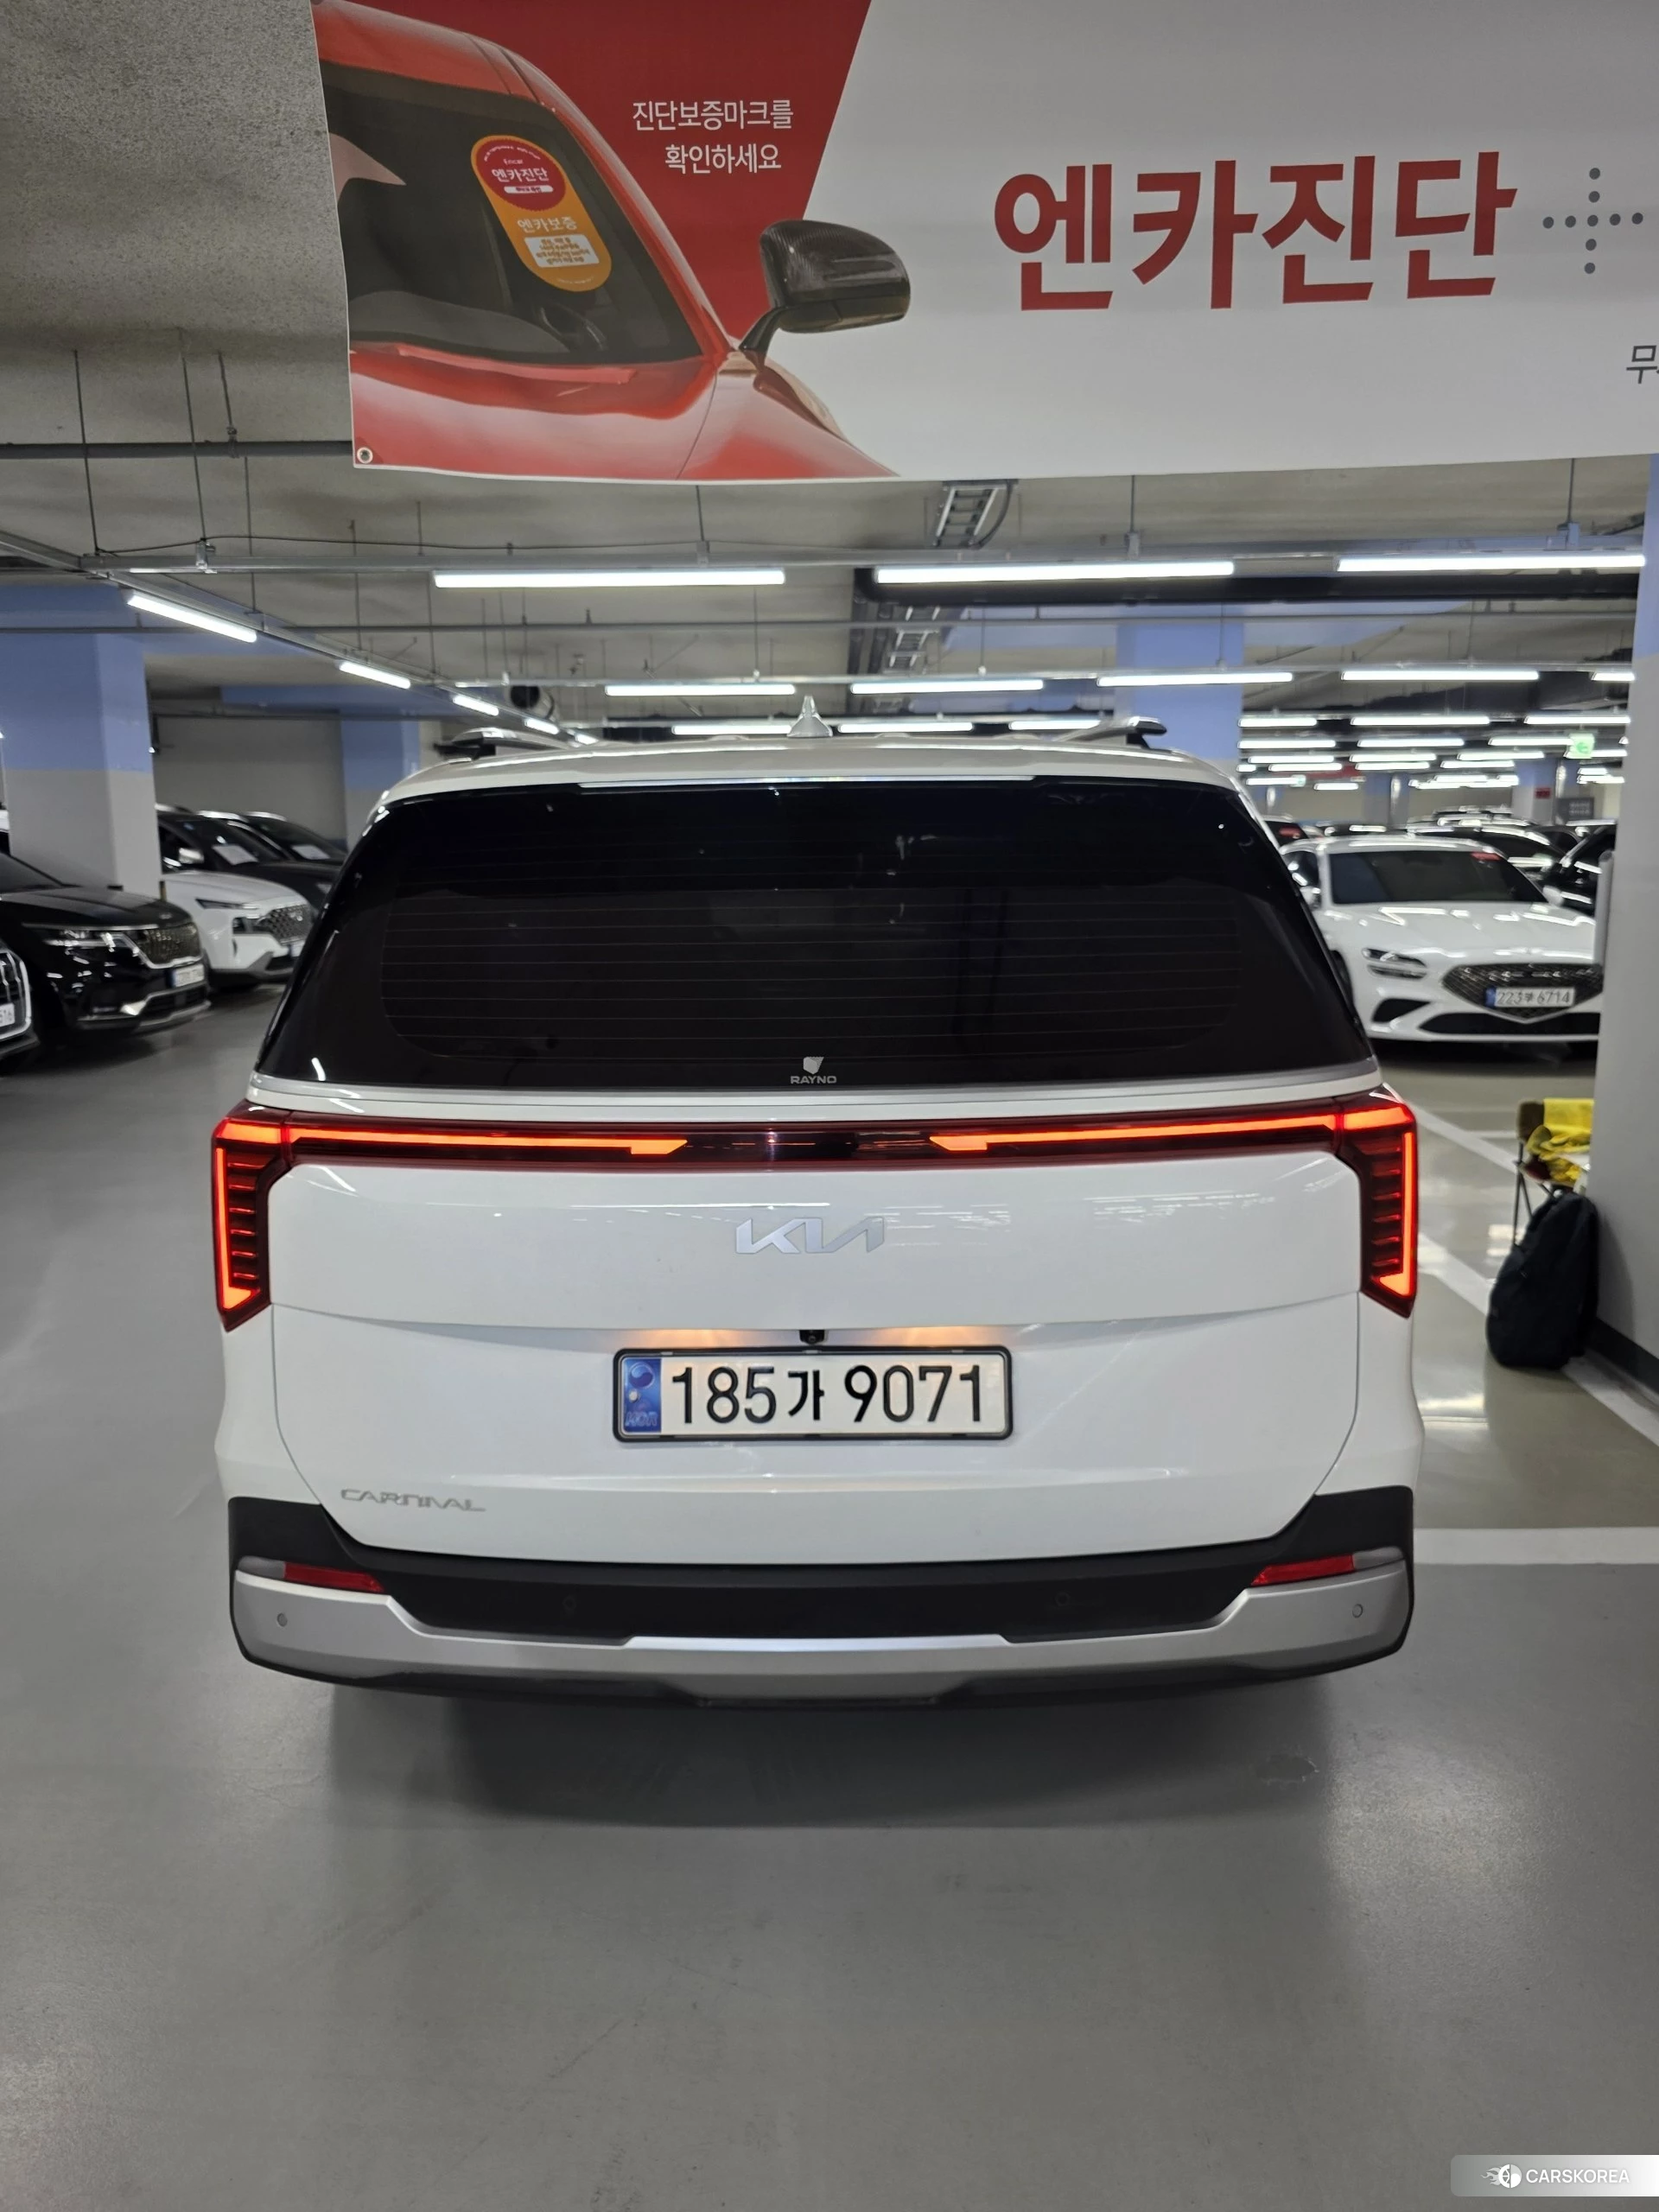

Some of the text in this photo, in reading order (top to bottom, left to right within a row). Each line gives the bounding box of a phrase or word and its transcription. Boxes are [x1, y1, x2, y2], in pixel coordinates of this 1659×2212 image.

[632, 99, 794, 130] 진단보증마크를
[664, 143, 782, 174] 확인하세요
[491, 167, 550, 183] 엔카진단
[517, 216, 578, 233] 엔카보증
[994, 151, 1518, 310] 엔카진단
[1626, 345, 1659, 385] 무
[790, 1075, 837, 1084] RAYNO
[734, 1217, 886, 1255] KIA
[671, 1363, 982, 1425] 185가 9071
